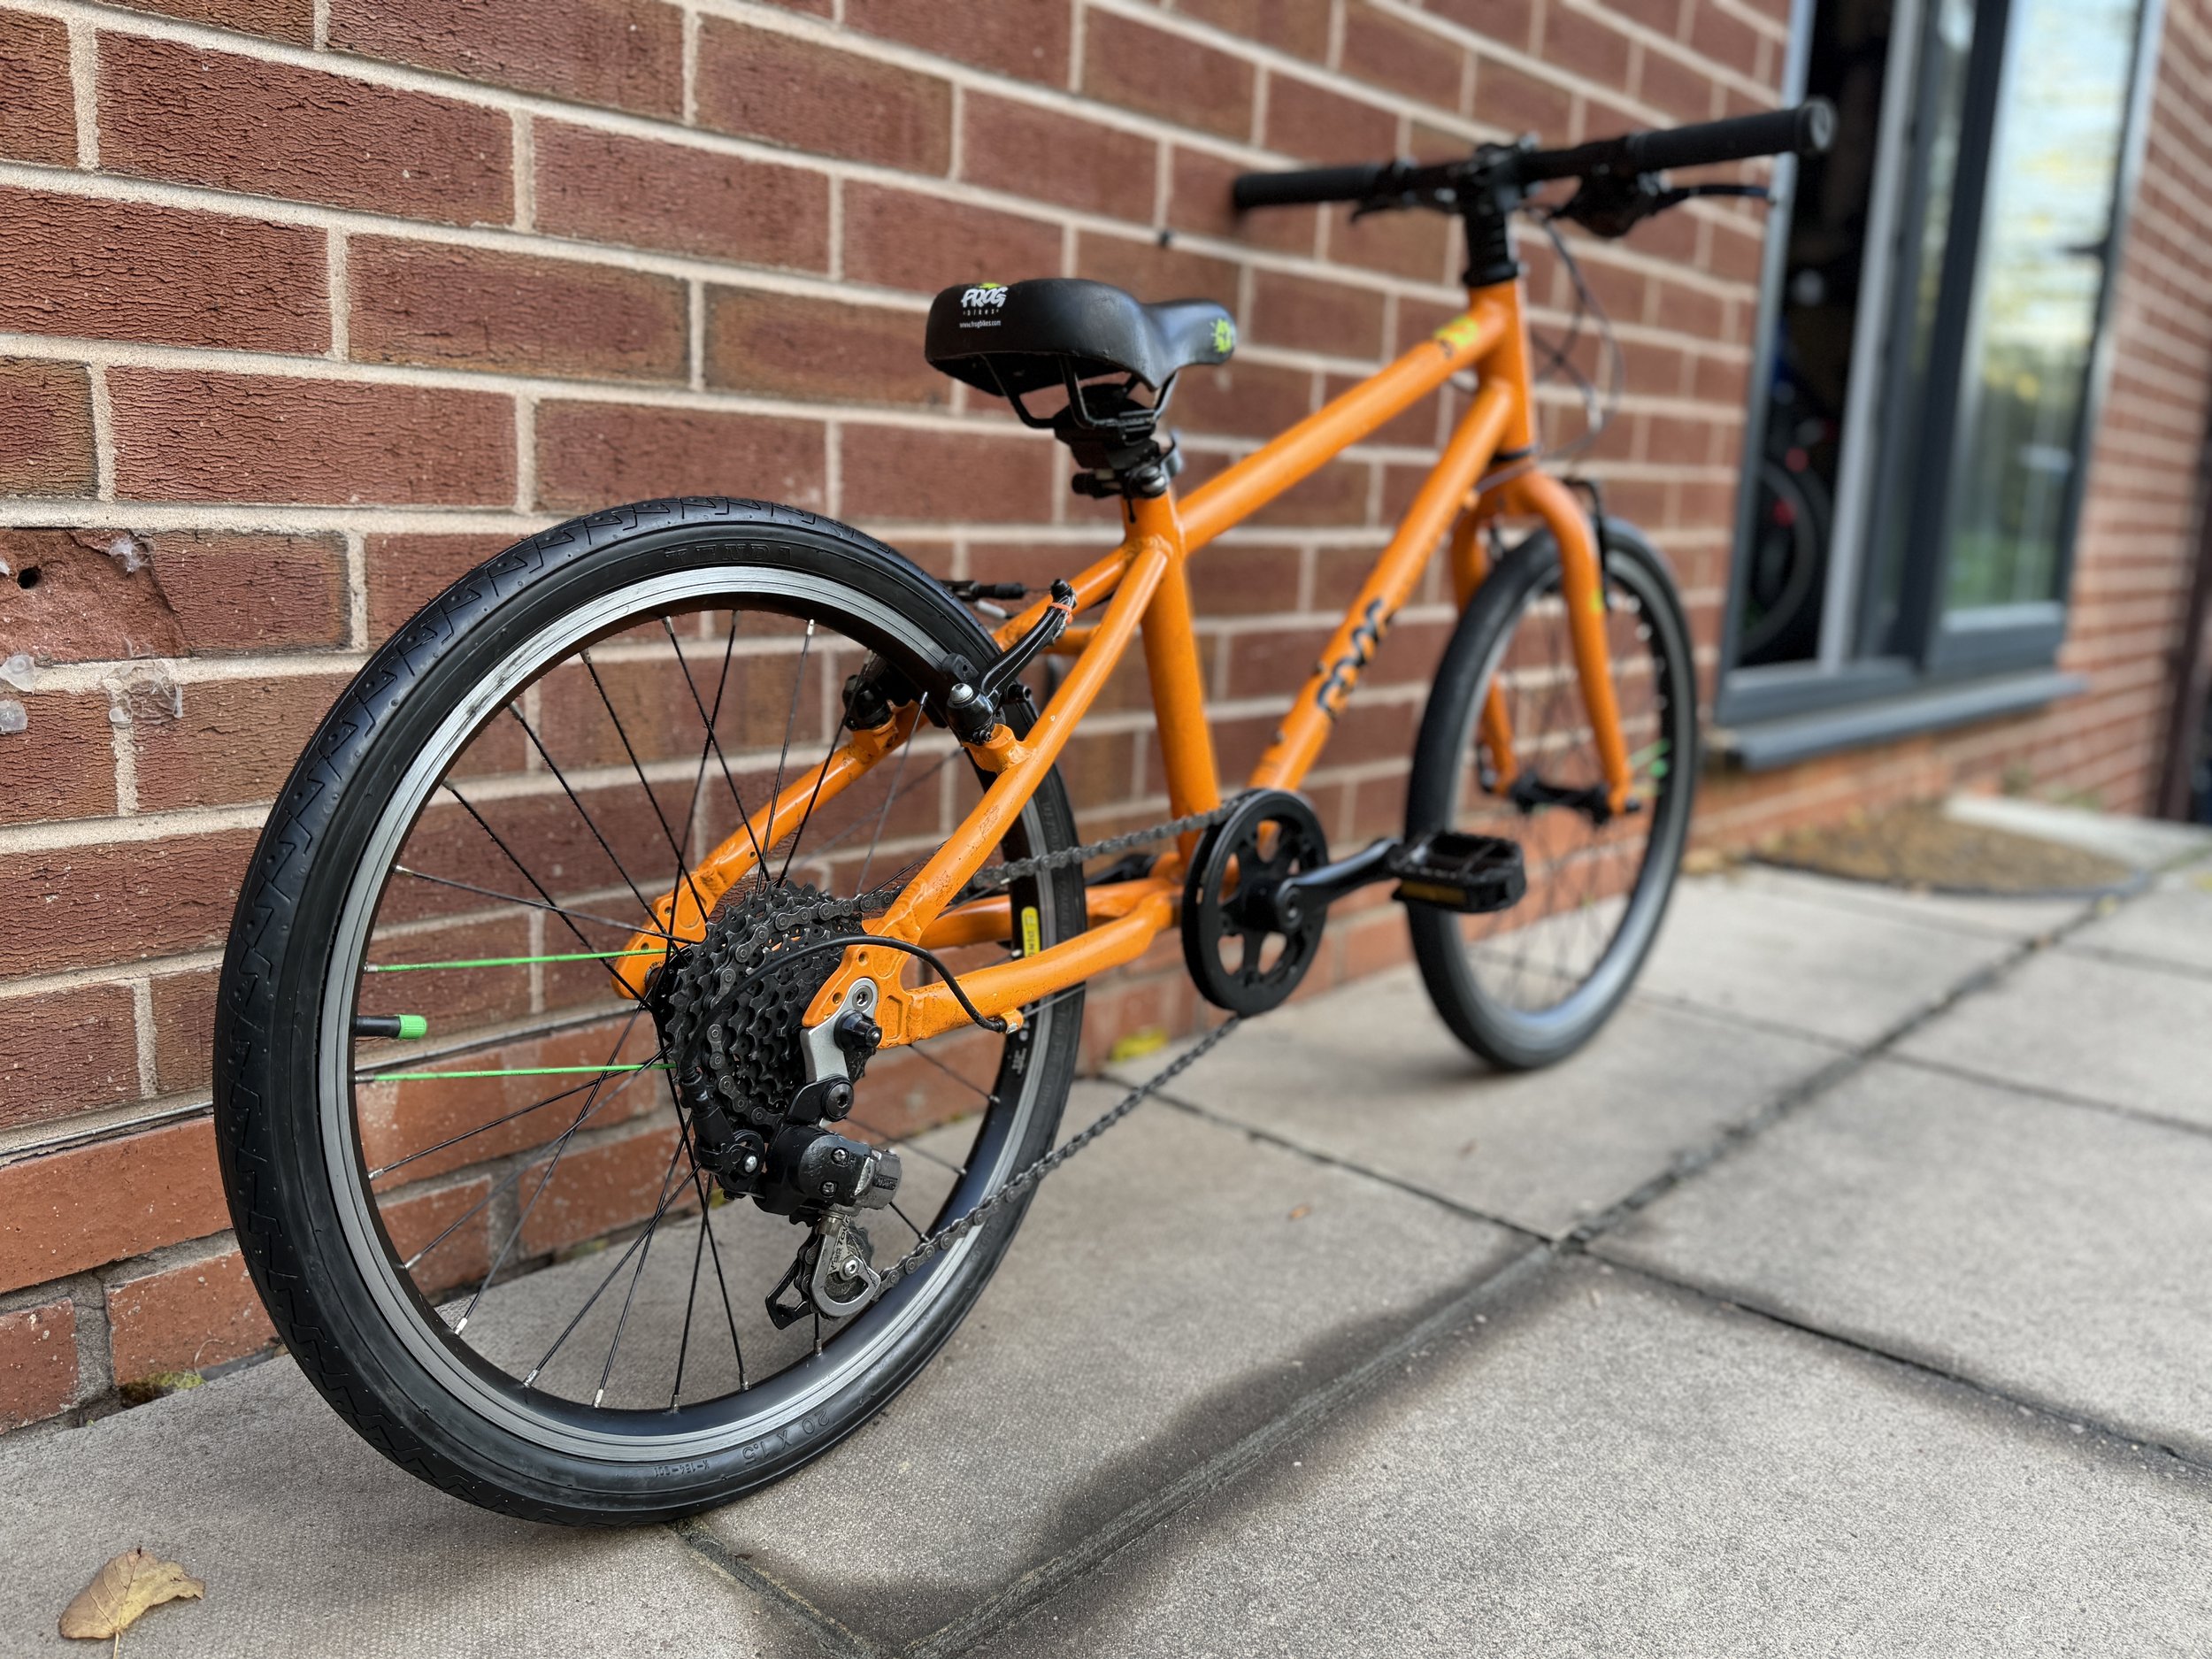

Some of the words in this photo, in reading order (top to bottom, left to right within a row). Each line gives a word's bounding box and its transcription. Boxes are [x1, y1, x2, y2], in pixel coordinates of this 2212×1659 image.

[961, 286, 1009, 308] FROG
[802, 1407, 830, 1434] 20
[742, 1440, 771, 1465] 1.5
